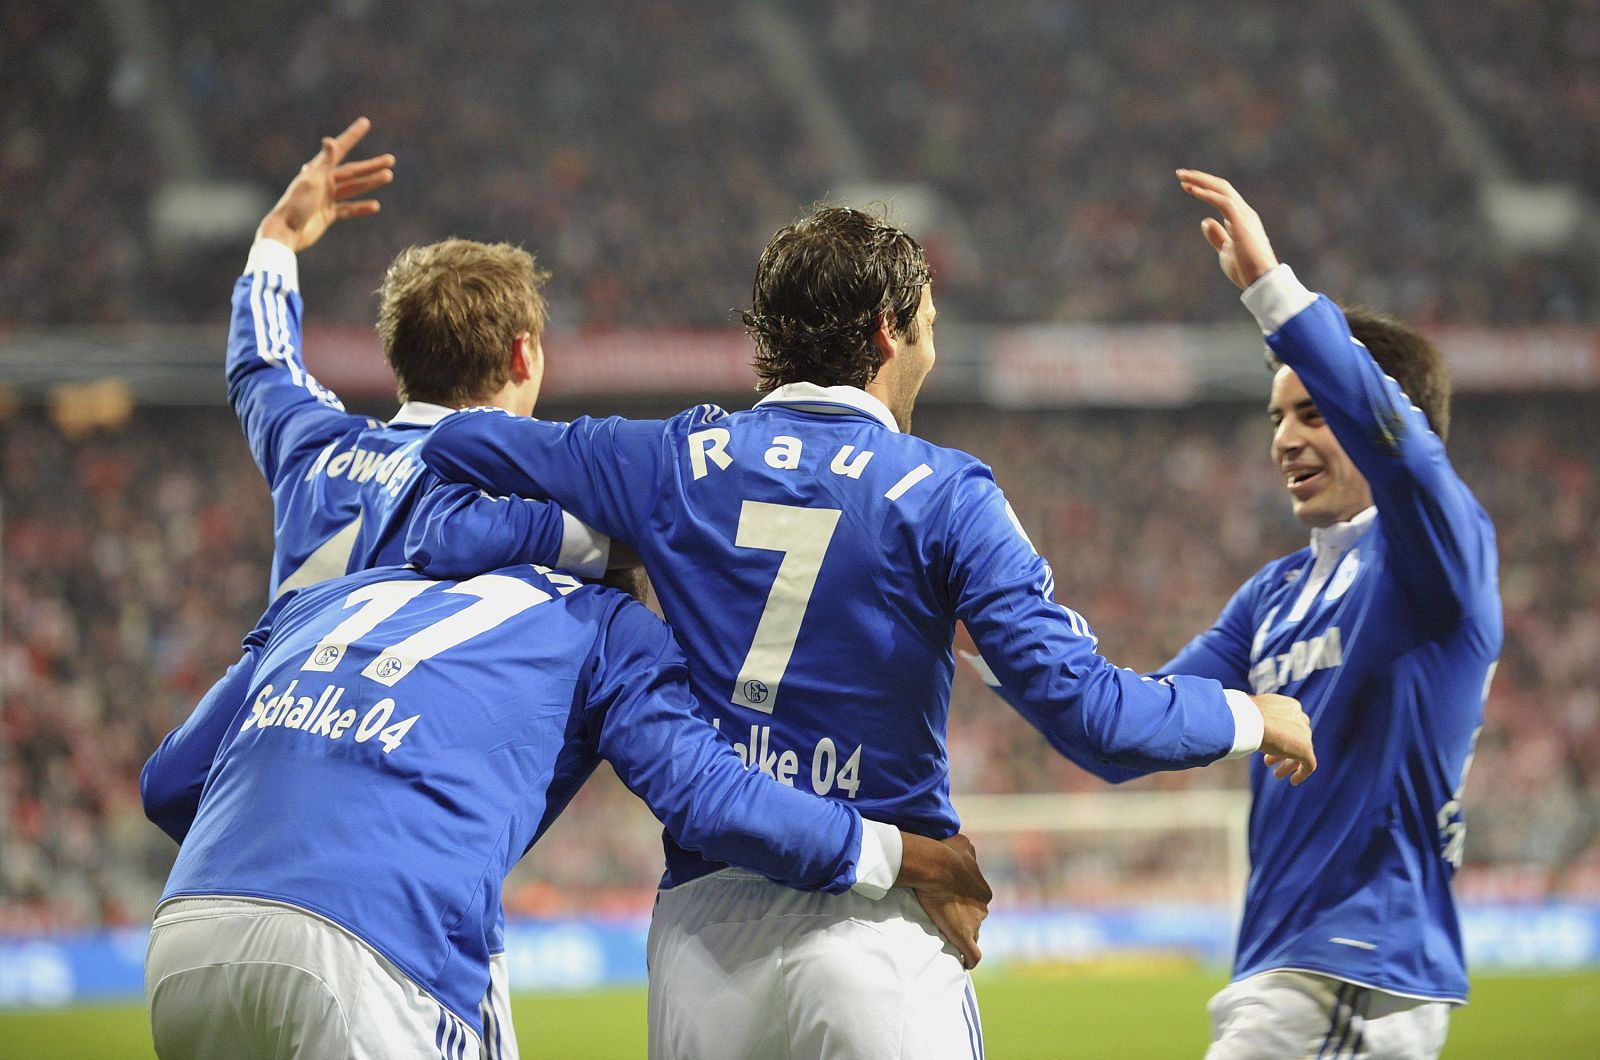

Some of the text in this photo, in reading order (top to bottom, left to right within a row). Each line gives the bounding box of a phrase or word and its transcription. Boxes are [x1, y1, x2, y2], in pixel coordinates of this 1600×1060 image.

[688, 427, 934, 501] Raul
[731, 499, 843, 716] 7
[240, 679, 421, 755] Schalke 04
[811, 737, 862, 799] 04
